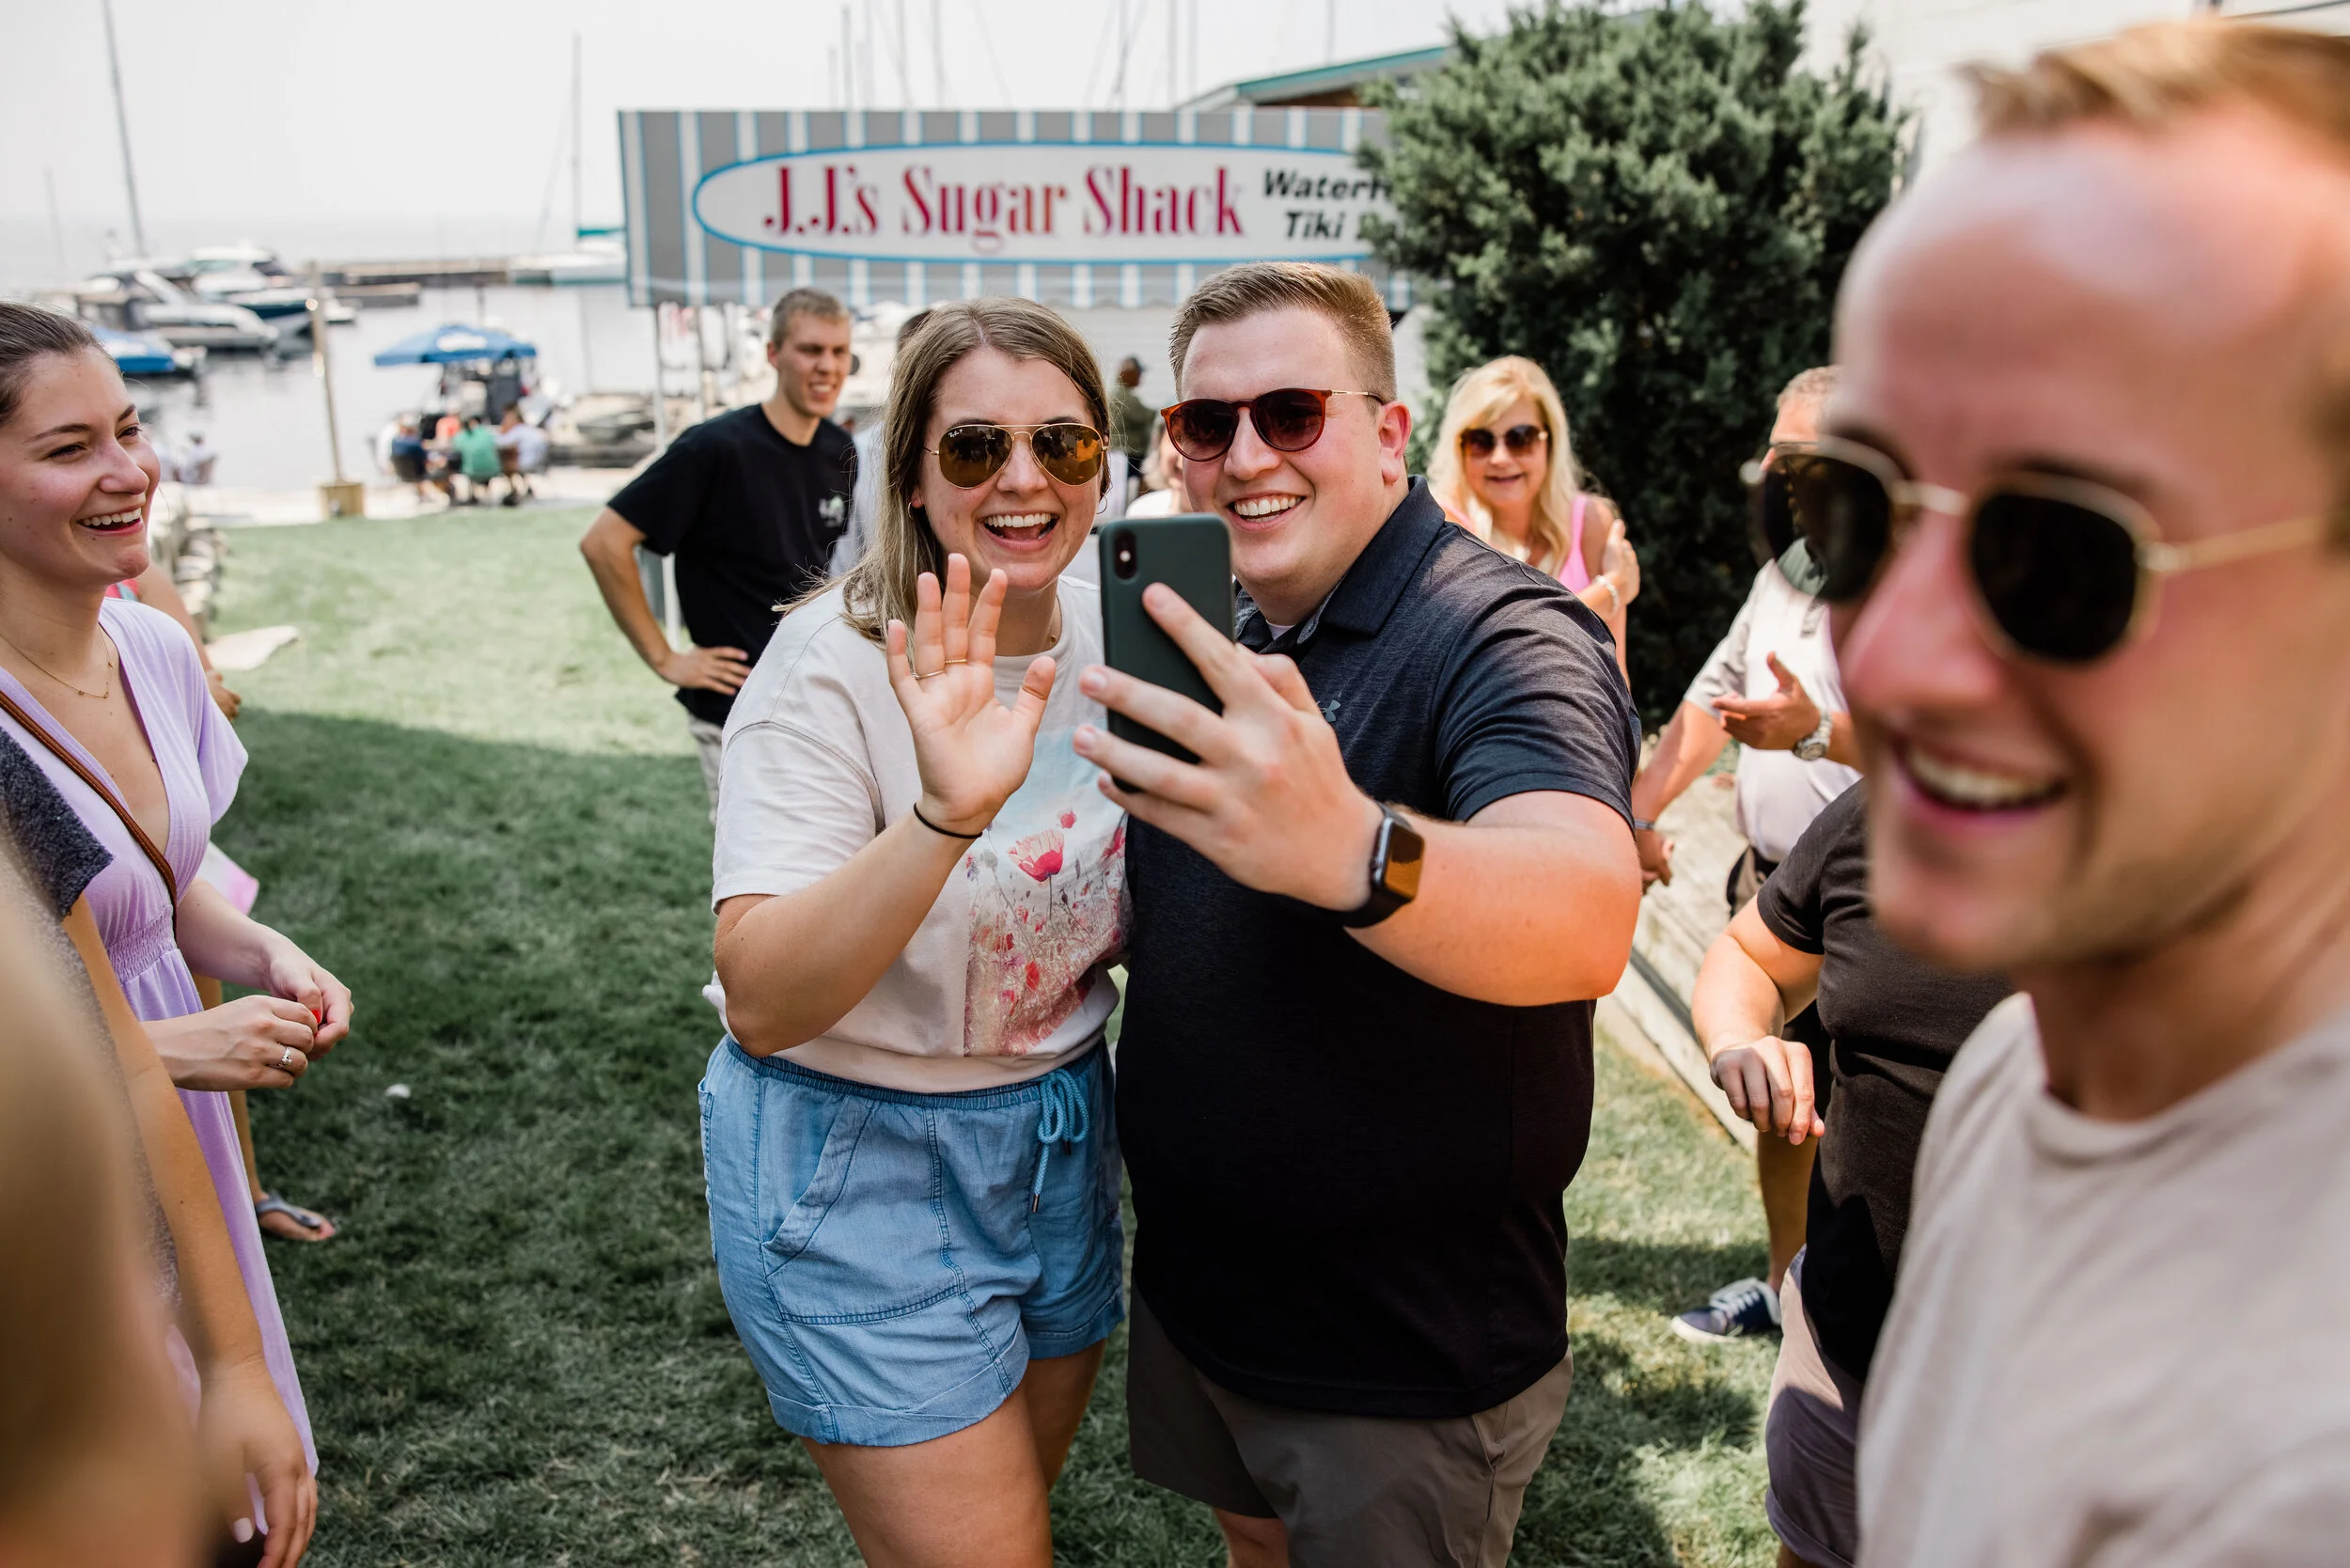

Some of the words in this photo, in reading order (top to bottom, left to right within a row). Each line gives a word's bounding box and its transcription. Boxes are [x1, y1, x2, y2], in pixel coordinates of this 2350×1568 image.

[900, 165, 1069, 256] Sugar
[1083, 164, 1246, 236] Shack
[1286, 210, 1346, 239] Tiki
